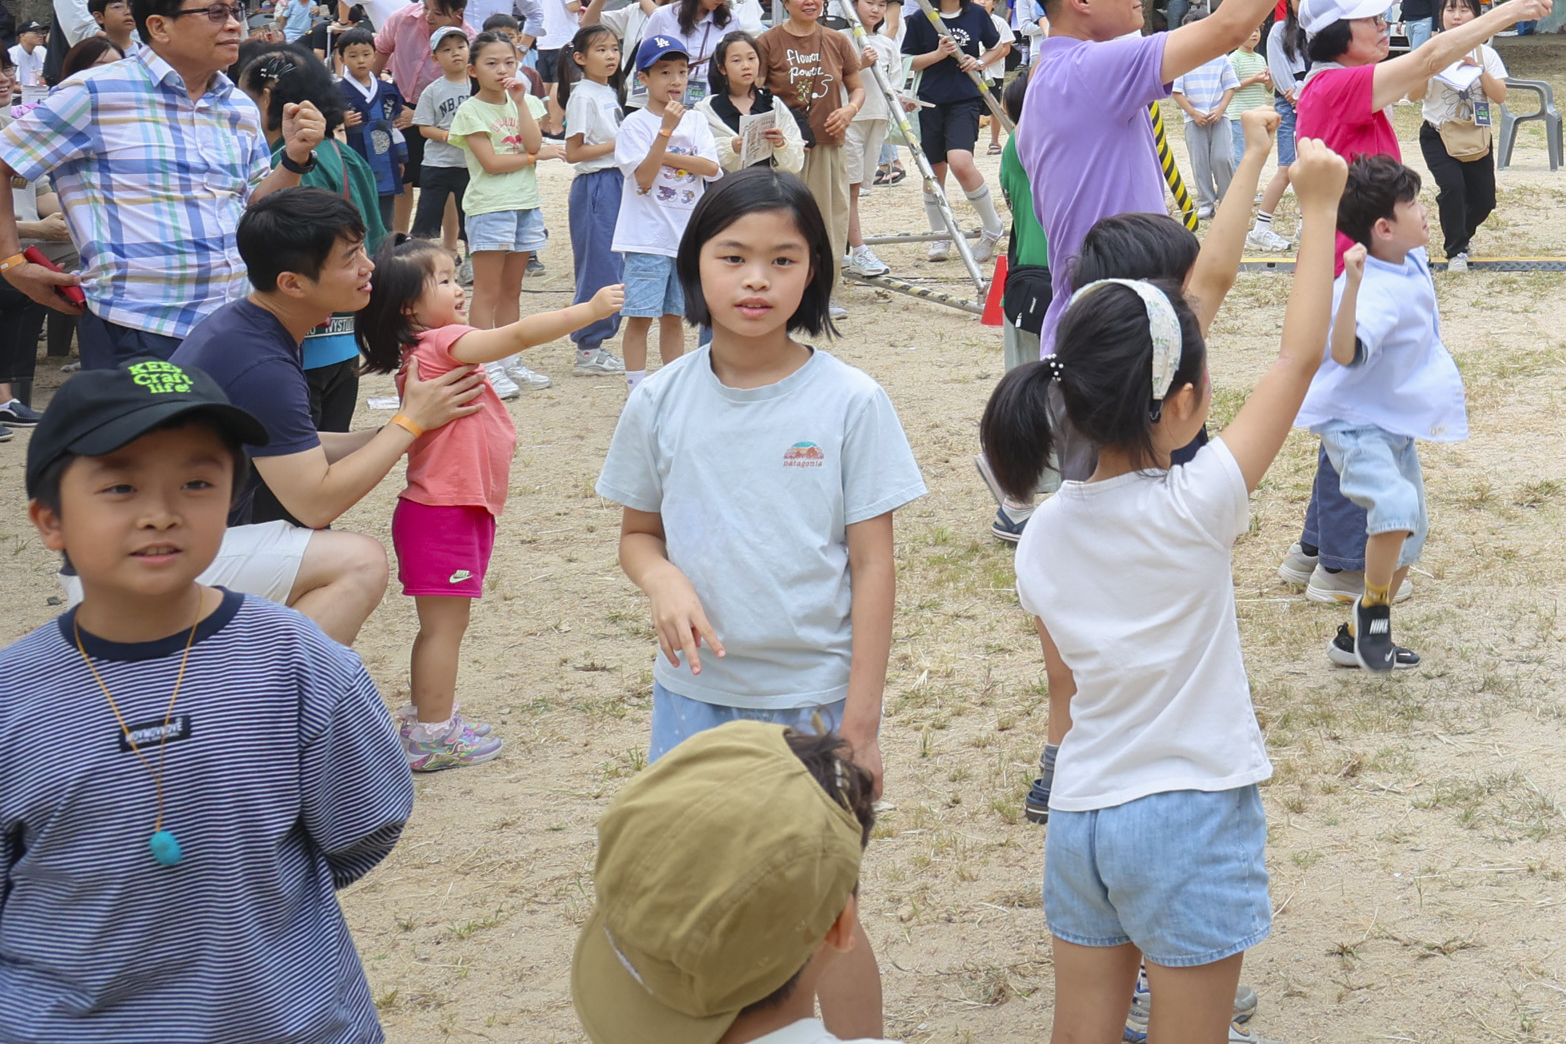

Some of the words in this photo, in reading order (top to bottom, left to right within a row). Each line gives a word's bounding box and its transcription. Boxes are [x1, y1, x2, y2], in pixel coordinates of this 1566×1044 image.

[786, 49, 821, 66] flower
[788, 66, 824, 84] power
[133, 373, 194, 385] Craft
[783, 460, 823, 468] patagonia
